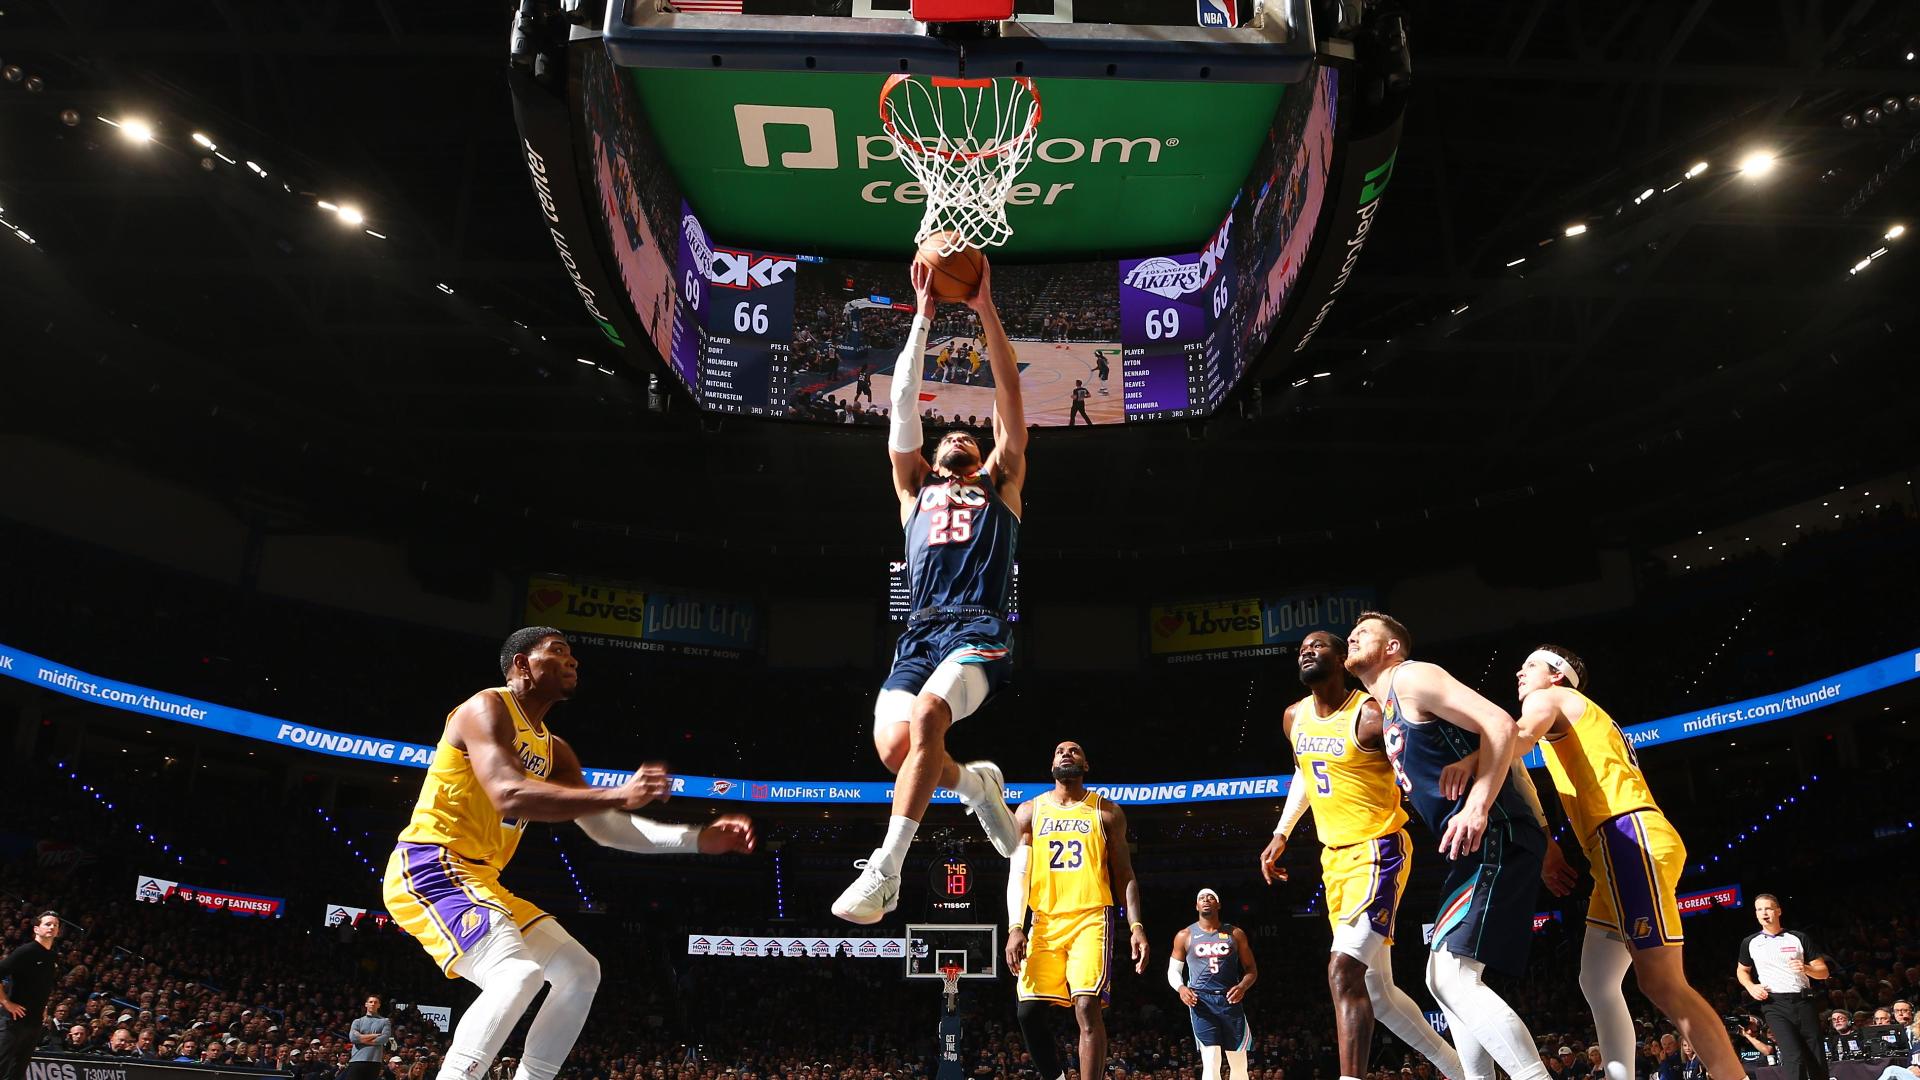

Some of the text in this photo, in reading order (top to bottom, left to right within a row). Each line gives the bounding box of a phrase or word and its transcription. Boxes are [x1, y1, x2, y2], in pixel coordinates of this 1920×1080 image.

[1204, 12, 1223, 25] NBA
[525, 138, 608, 320] paycom center
[1330, 198, 1379, 294] paycom
[686, 270, 700, 310] 69
[1126, 271, 1198, 290] LAKERS
[1214, 275, 1228, 319] 66
[734, 302, 768, 334] 66
[1145, 308, 1180, 340] 69
[709, 336, 730, 344] PLAYER
[706, 369, 732, 378] WALLACE
[707, 358, 738, 367] HOLMGREN
[706, 380, 734, 389] MITCHELL
[1125, 402, 1158, 410] HACHIMURA
[920, 482, 986, 511] OKC
[928, 509, 973, 546] 25
[566, 594, 642, 623] Loves
[1268, 600, 1319, 637] LOUD
[649, 602, 752, 642] LOUD CITY
[1187, 614, 1260, 636] Loves
[581, 636, 606, 646] THE
[609, 638, 665, 652] THUNDER
[683, 647, 710, 656] EXIT
[712, 650, 740, 660] NOW
[1168, 647, 1287, 664] BRING THE THUNDER
[38, 668, 208, 720] midfirst.com/thunder
[1682, 682, 1842, 732] midfirst.com/thunder
[276, 724, 395, 758] FOUNDING
[1295, 733, 1345, 756] LAKERS
[1192, 779, 1279, 798] PARTNER
[1312, 762, 1331, 797] 5
[829, 787, 861, 798] BANK
[1037, 817, 1091, 836] LAKERS
[1048, 840, 1083, 872] 23
[944, 864, 966, 874] 7:46
[948, 875, 964, 894] 18
[1685, 893, 1730, 908] GREATESS!
[1194, 942, 1230, 956] OKC
[1210, 958, 1219, 974] 5
[946, 1043, 955, 1051] THE
